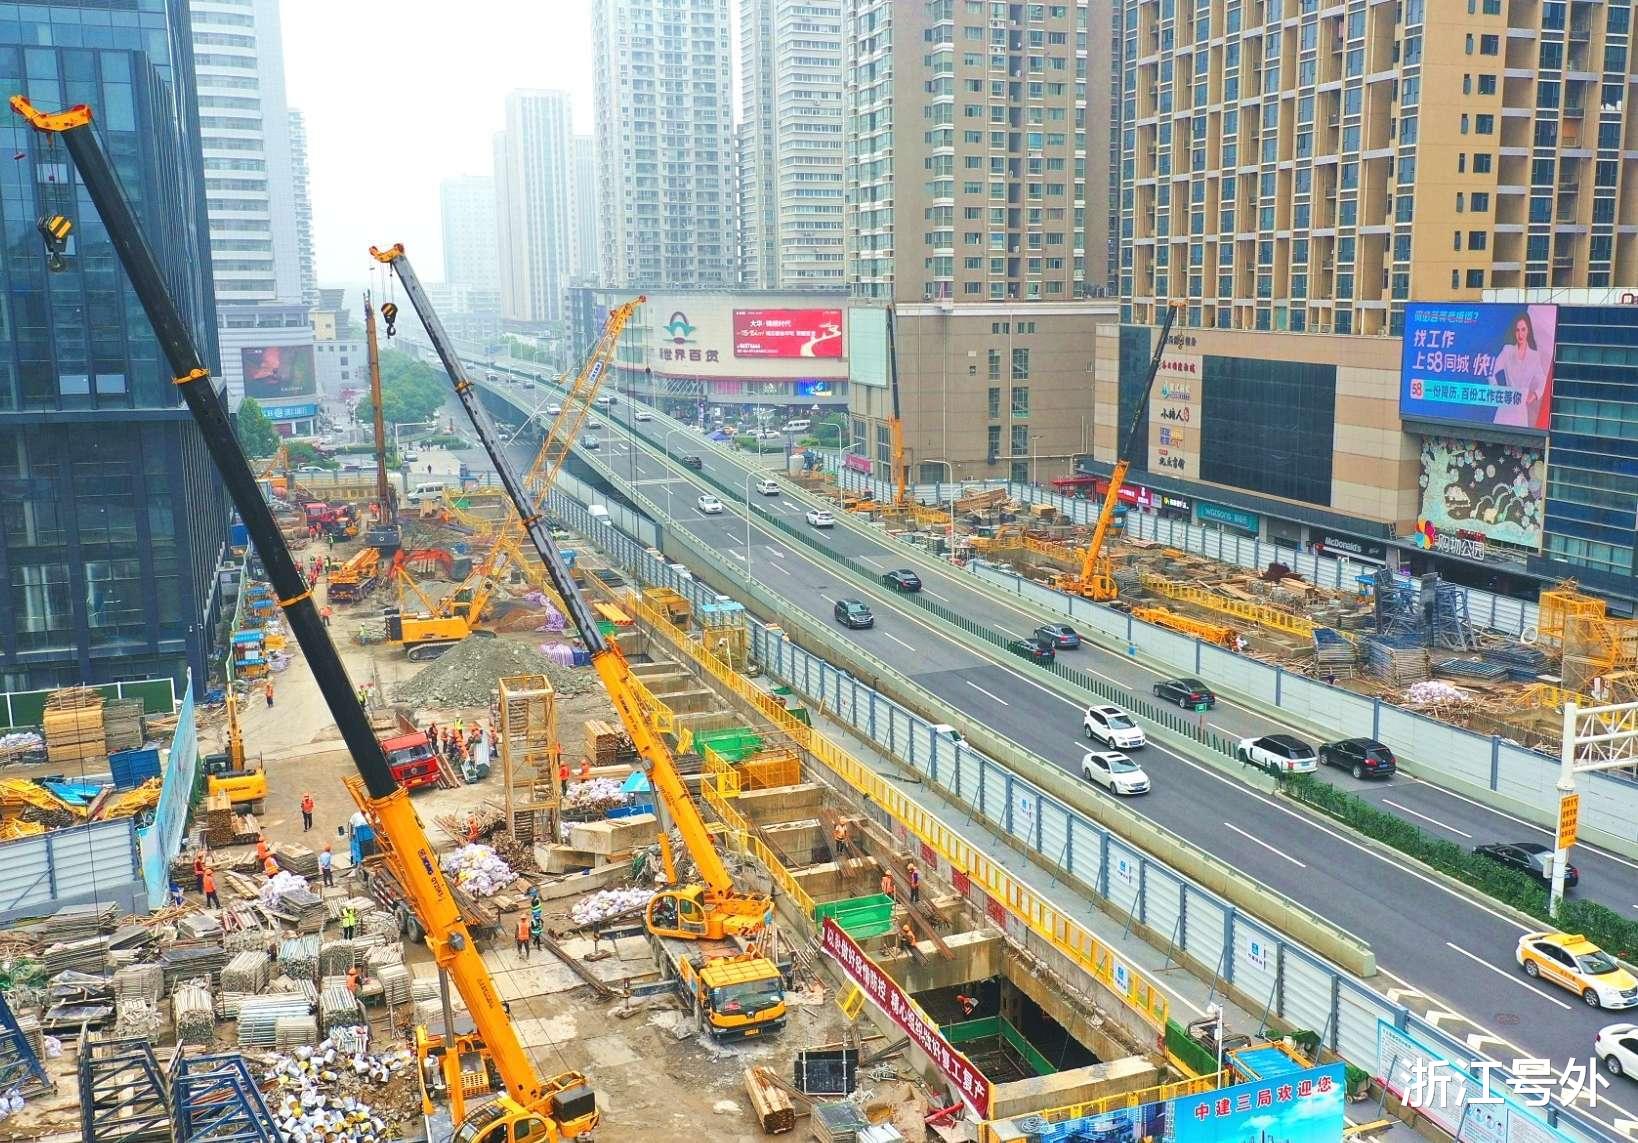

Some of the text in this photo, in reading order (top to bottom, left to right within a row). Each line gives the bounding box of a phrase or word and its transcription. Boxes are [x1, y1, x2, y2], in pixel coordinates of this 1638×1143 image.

[1413, 329, 1456, 349] 找工作
[1412, 351, 1496, 377] 上58同城 快!
[1411, 381, 1423, 396] 58
[1324, 536, 1362, 553] McDonald's
[1194, 1075, 1333, 1122] 中建三局欢迎您
